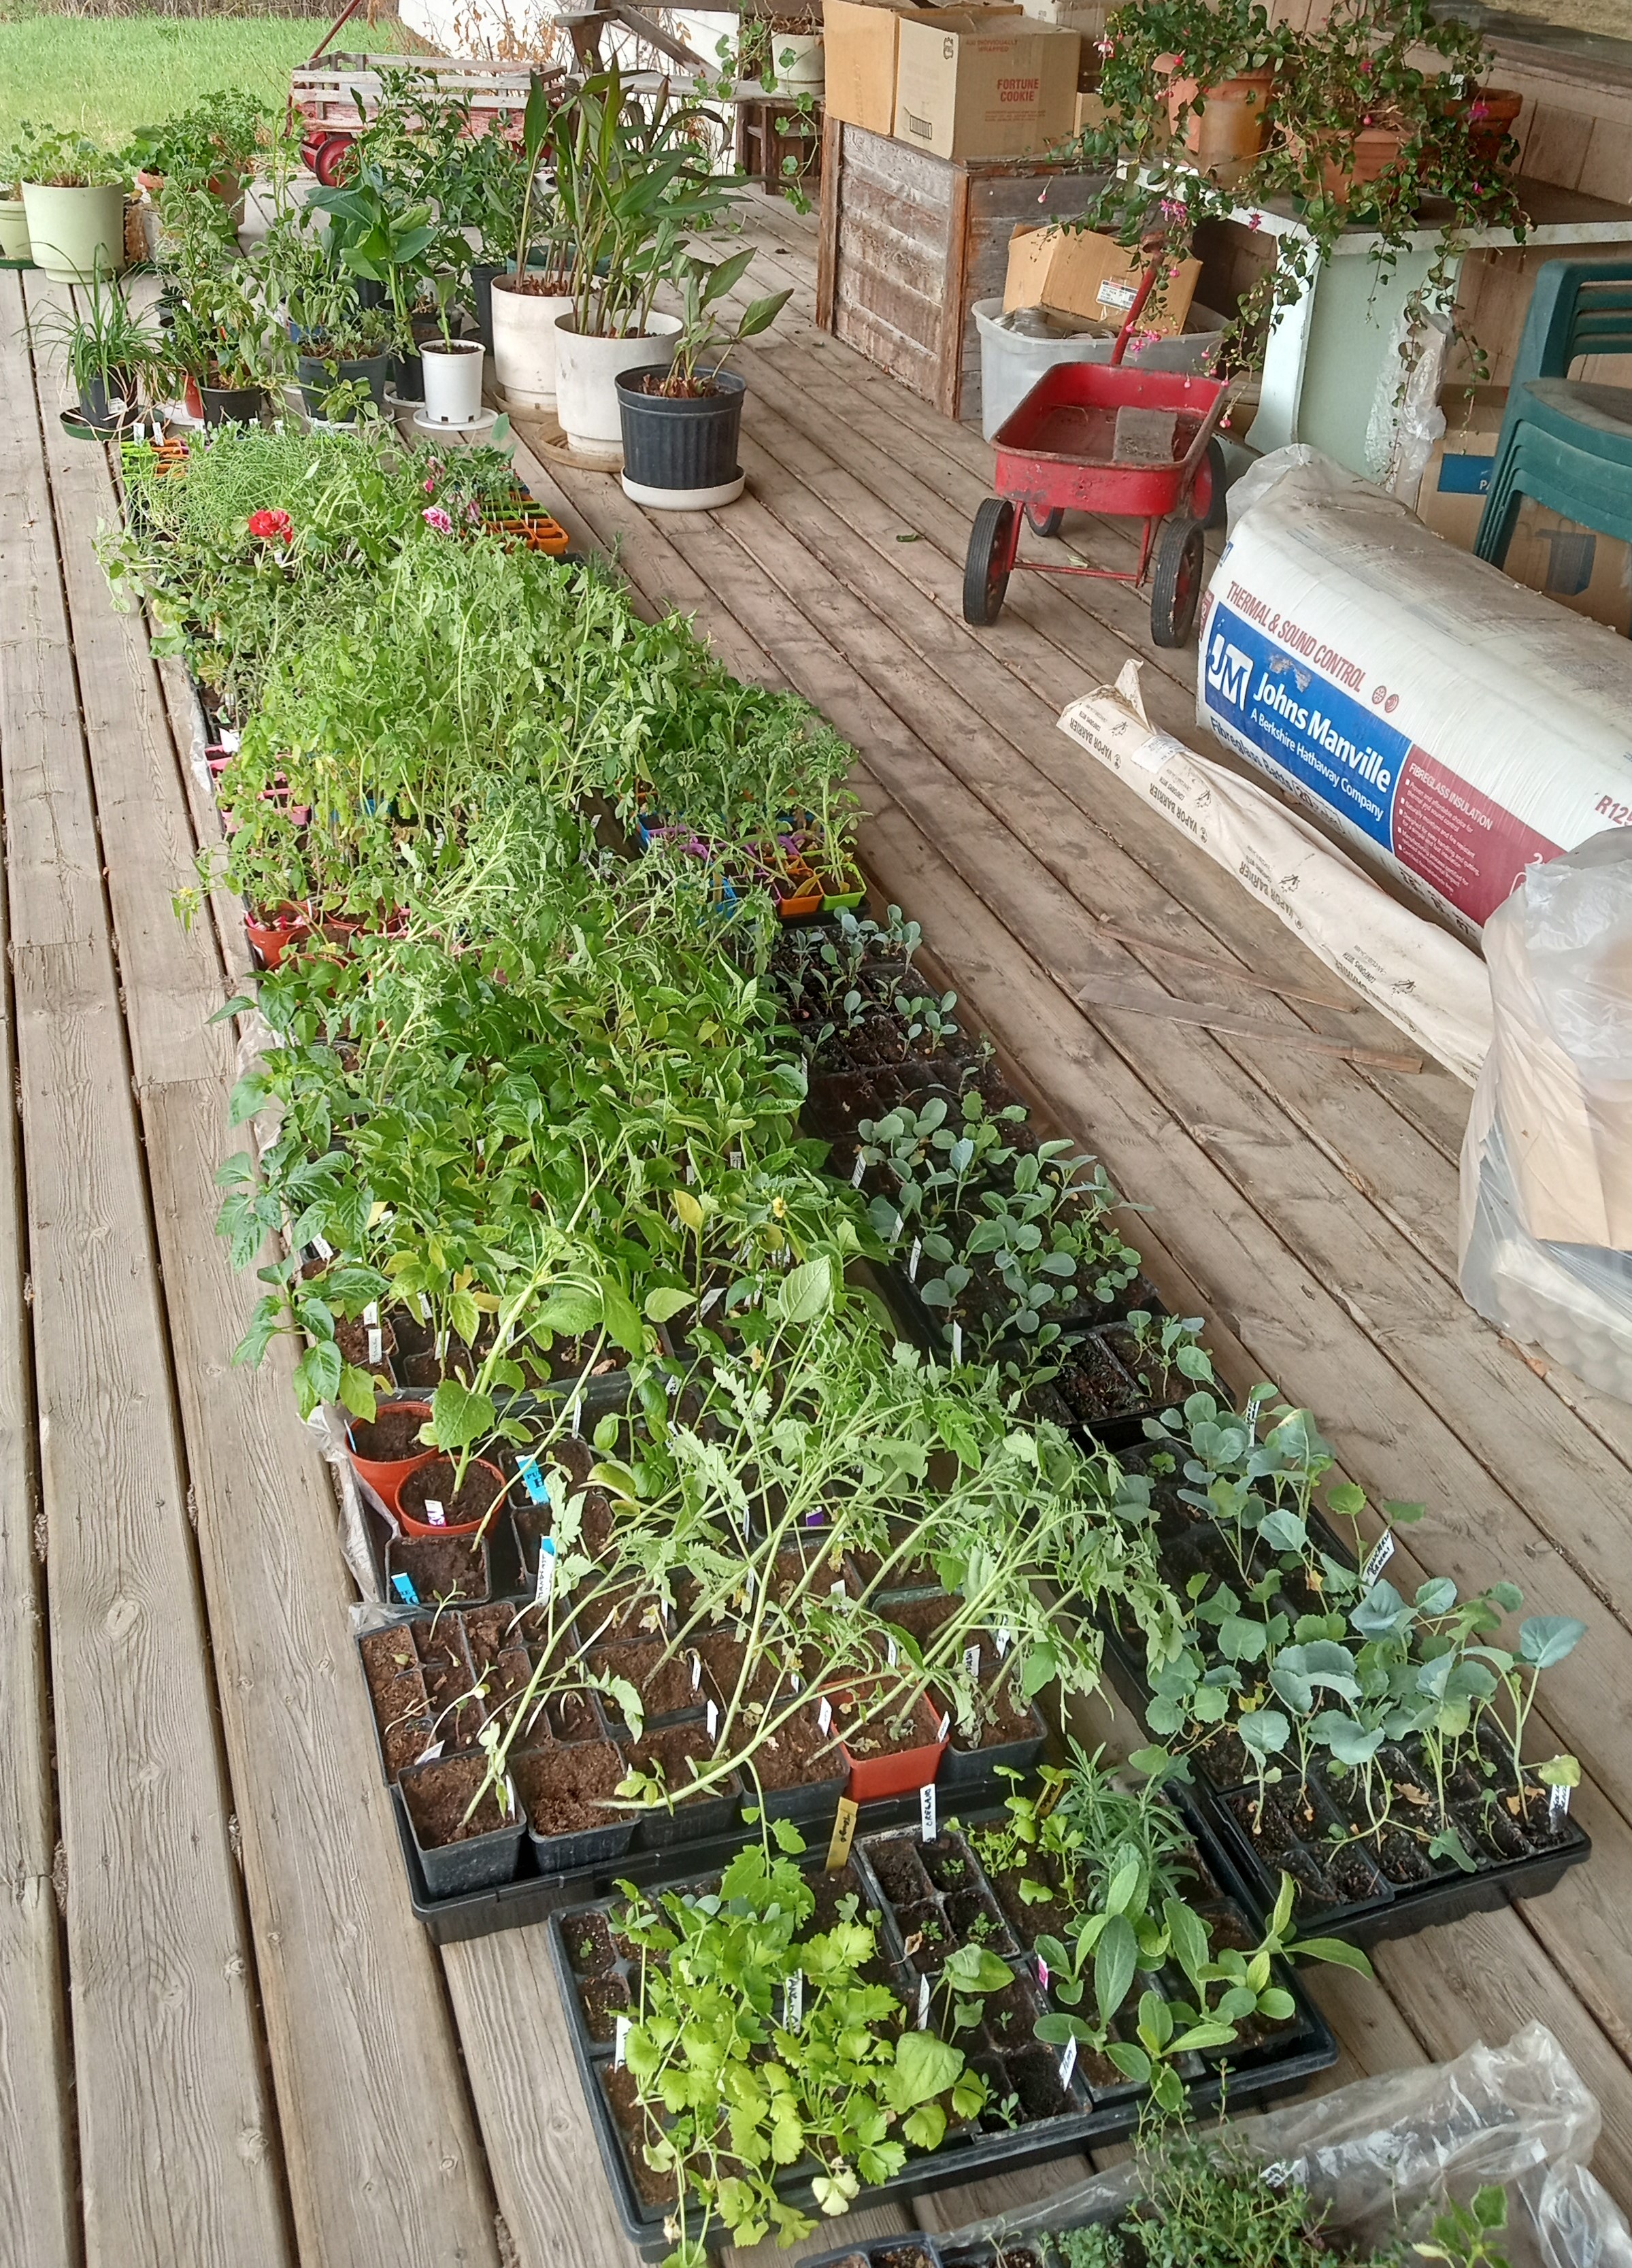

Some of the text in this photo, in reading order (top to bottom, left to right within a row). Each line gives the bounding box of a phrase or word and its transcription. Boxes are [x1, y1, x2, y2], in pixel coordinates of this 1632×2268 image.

[997, 78, 1039, 90] FORTUNE
[1000, 91, 1035, 102] COOKIE
[1227, 580, 1271, 627] THERMAL
[1268, 614, 1280, 634] &
[1278, 620, 1317, 657] SOUND
[1314, 645, 1366, 693] CONTROL
[1207, 633, 1254, 712] JM
[1069, 717, 1094, 745] BARRIER
[1078, 710, 1087, 720] WITH
[1086, 716, 1101, 732] CONFORMS
[1253, 672, 1391, 793] Johns Manville
[1093, 737, 1112, 761] VAPOR
[1210, 715, 1263, 768] Fibreglass
[1261, 757, 1293, 791] Batts
[1250, 708, 1258, 723] A
[1259, 713, 1296, 752] Berkshire
[1296, 742, 1340, 788] Hathaway
[1341, 778, 1384, 821] Company
[1159, 776, 1169, 787] WITH
[1167, 783, 1185, 801] CONFORMS
[1409, 762, 1494, 831] FIBREGLASS INSULATION
[1149, 783, 1198, 834] VAPOR BARRIER
[1404, 800, 1476, 858] Naturally moisture and fire resistant
[1407, 789, 1423, 804] thermal
[1431, 808, 1444, 821] sound
[1443, 818, 1460, 832] control
[1410, 782, 1473, 833] Proven and affordable choice for
[1403, 811, 1422, 829] Designed
[1427, 832, 1437, 842] easy
[1437, 838, 1456, 858] handling
[1455, 853, 1465, 863] and
[1342, 951, 1355, 965] WITH
[1354, 960, 1376, 984] CONFORMS
[1367, 1531, 1389, 1576] MUNCHKIN
[924, 1788, 932, 1826] OREGANO
